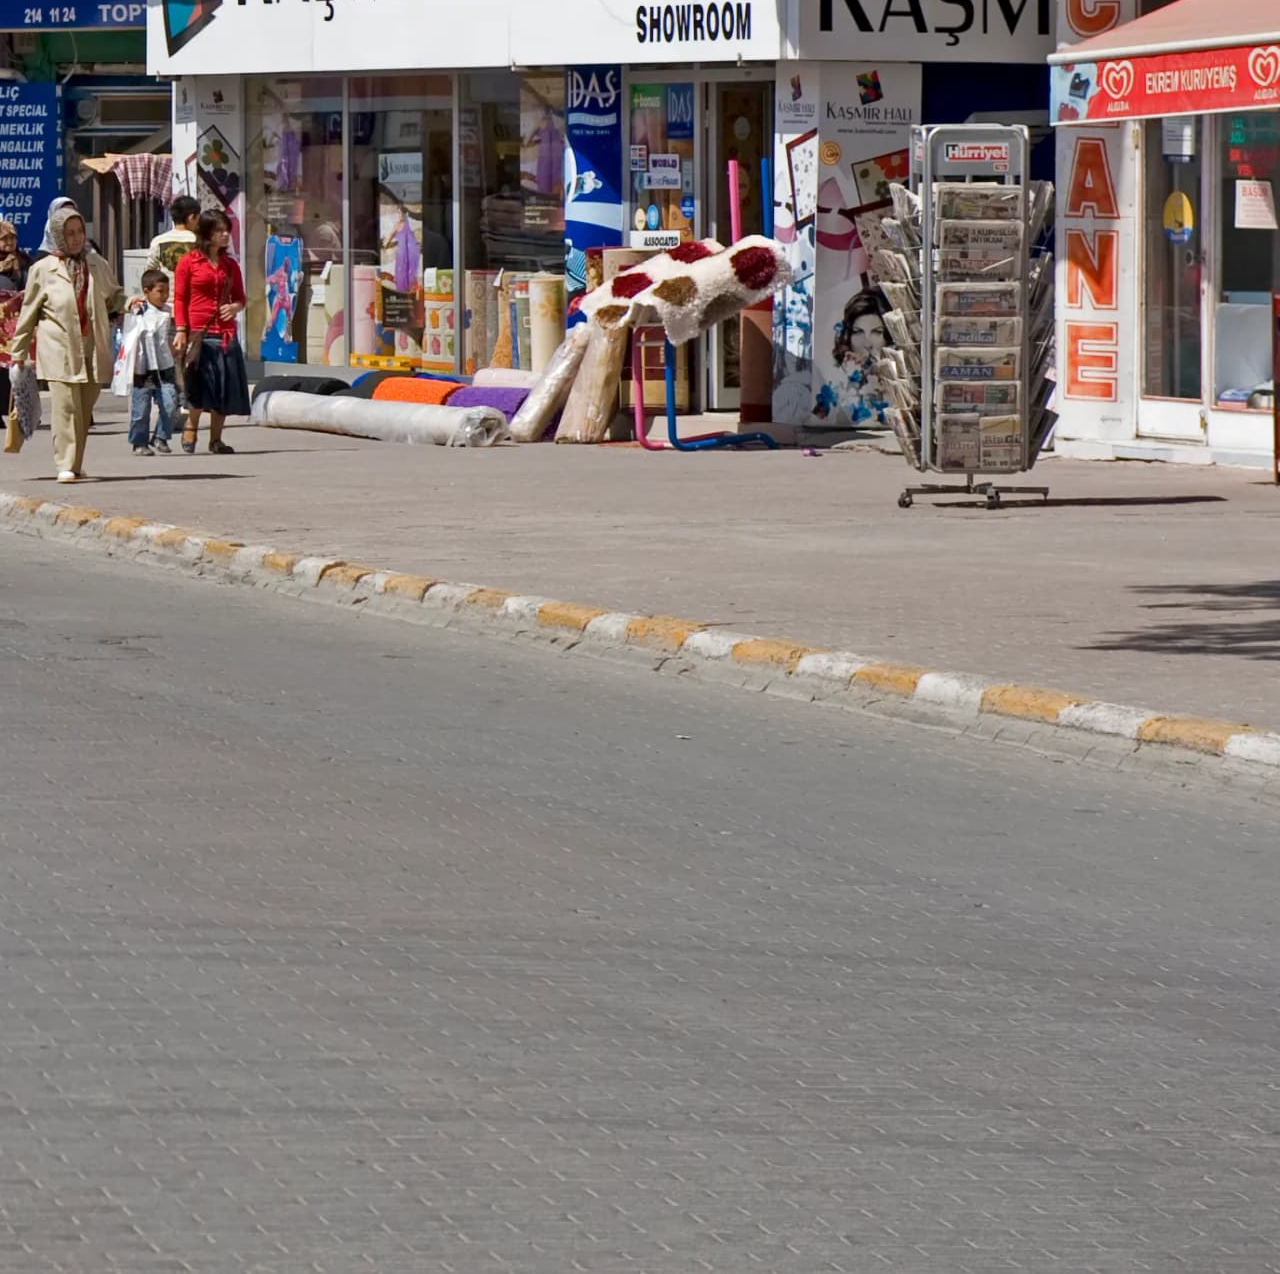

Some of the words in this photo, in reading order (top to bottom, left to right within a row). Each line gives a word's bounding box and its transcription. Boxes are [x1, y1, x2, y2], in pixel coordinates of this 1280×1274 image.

[24, 8, 42, 24] 214
[49, 8, 60, 23] 11
[63, 7, 77, 23] 24
[98, 3, 147, 23] TOP
[636, 1, 752, 44] SHOWROOM
[1145, 71, 1179, 95] EKREM
[946, 144, 1009, 161] Hürriyet
